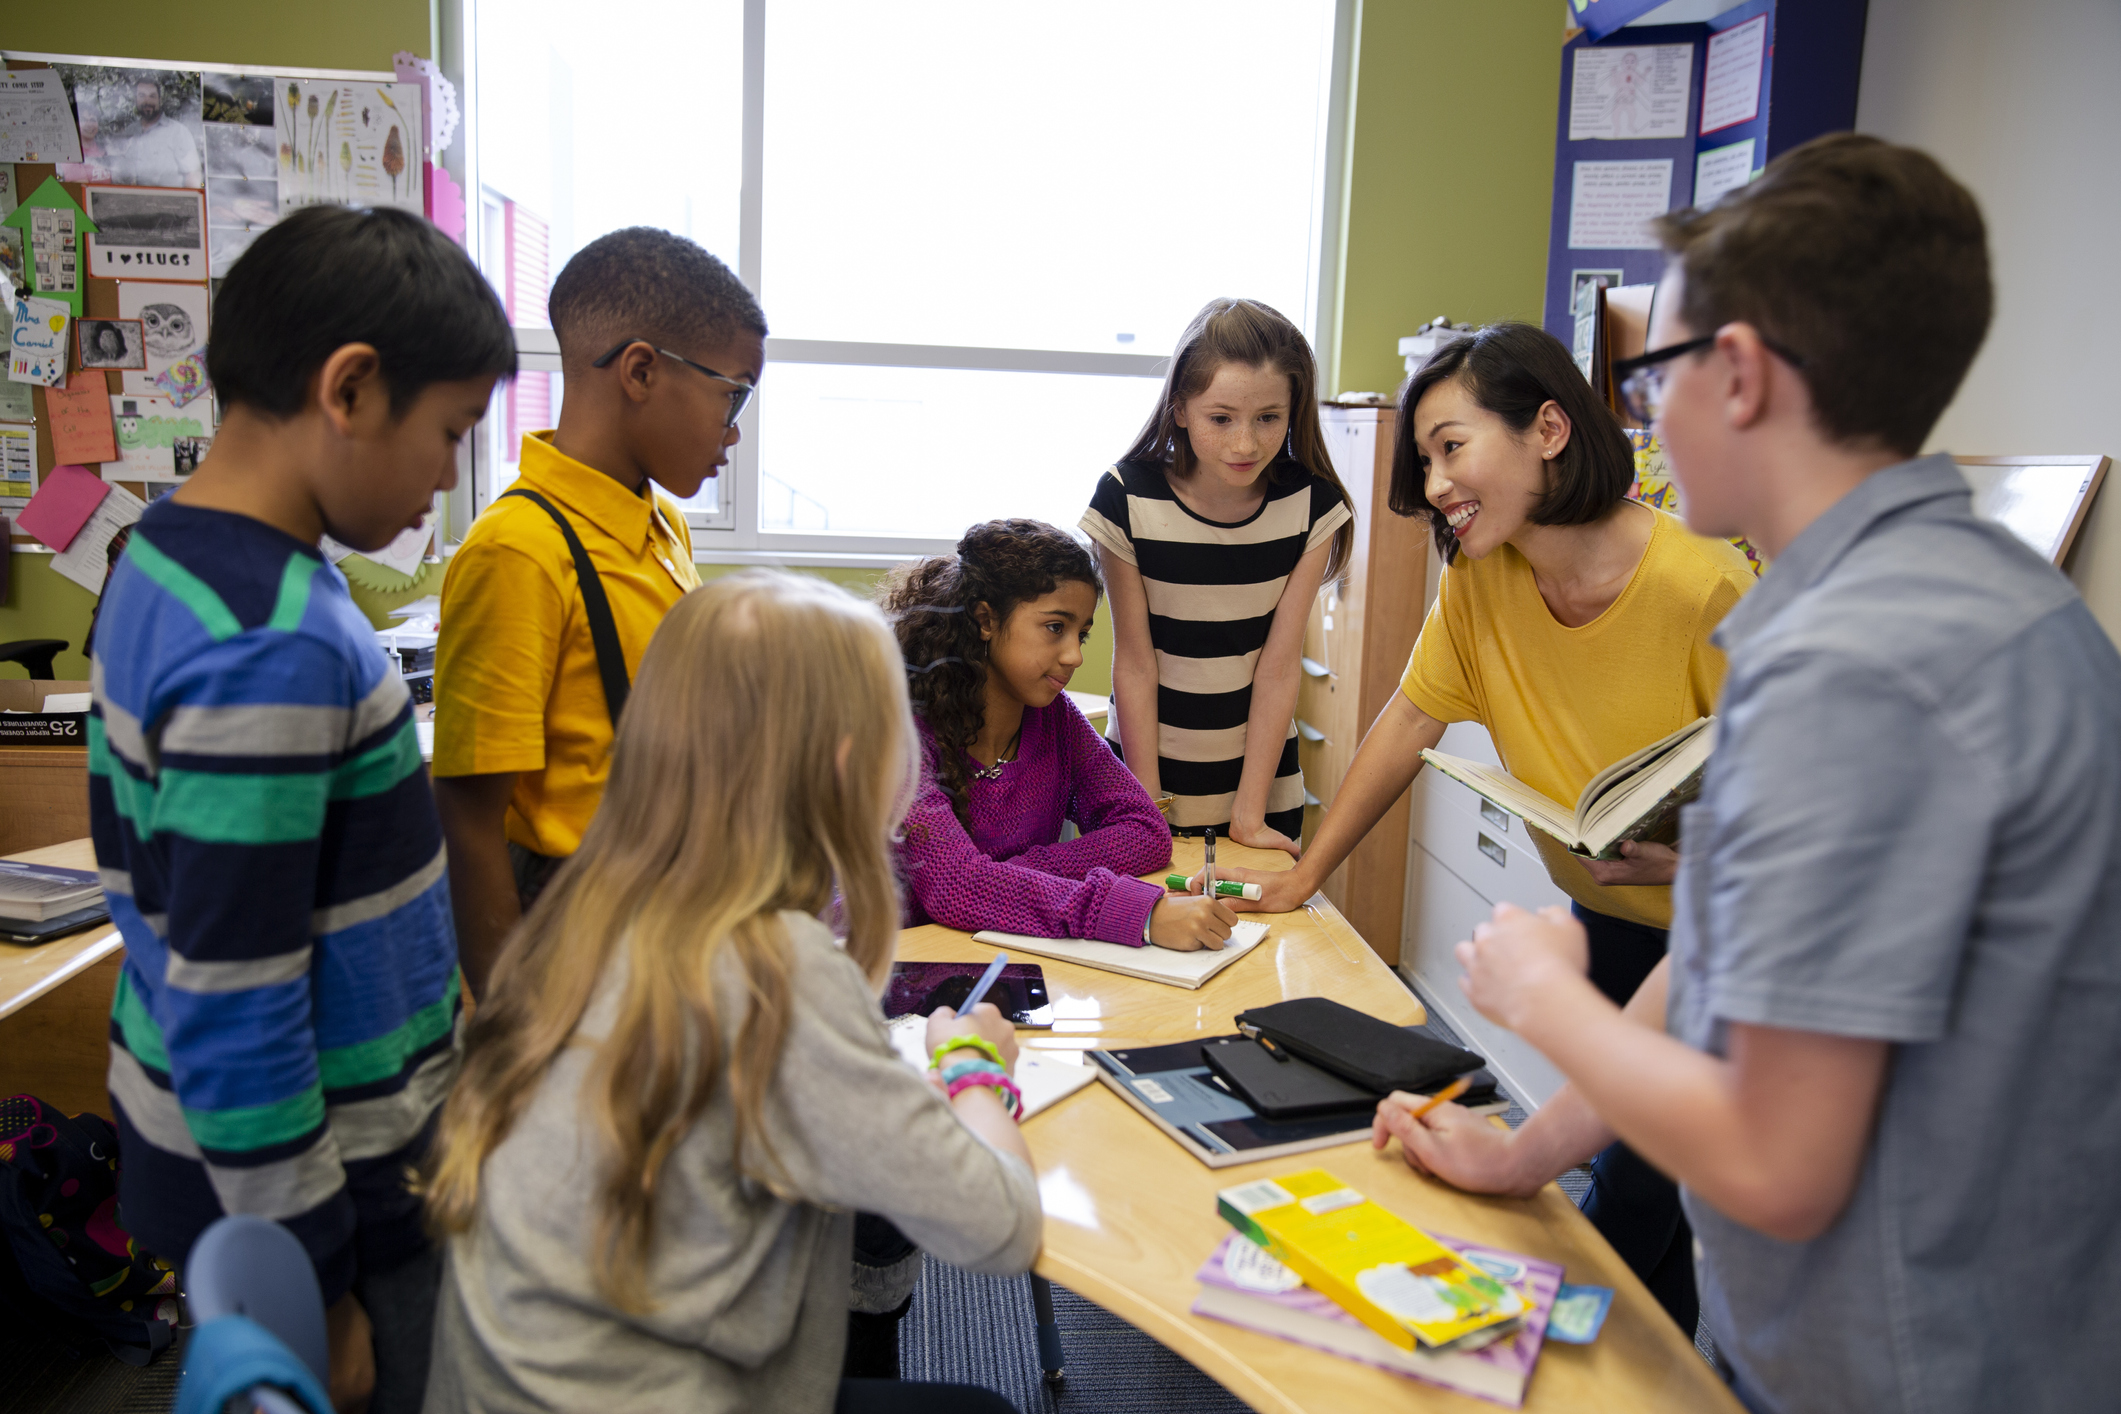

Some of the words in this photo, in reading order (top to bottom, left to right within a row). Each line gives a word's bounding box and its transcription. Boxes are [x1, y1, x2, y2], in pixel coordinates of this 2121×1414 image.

[107, 251, 113, 263] I
[136, 252, 190, 266] SLUGS
[16, 301, 40, 325] Mrs
[1645, 460, 1668, 475] Kyle
[49, 720, 78, 736] 25
